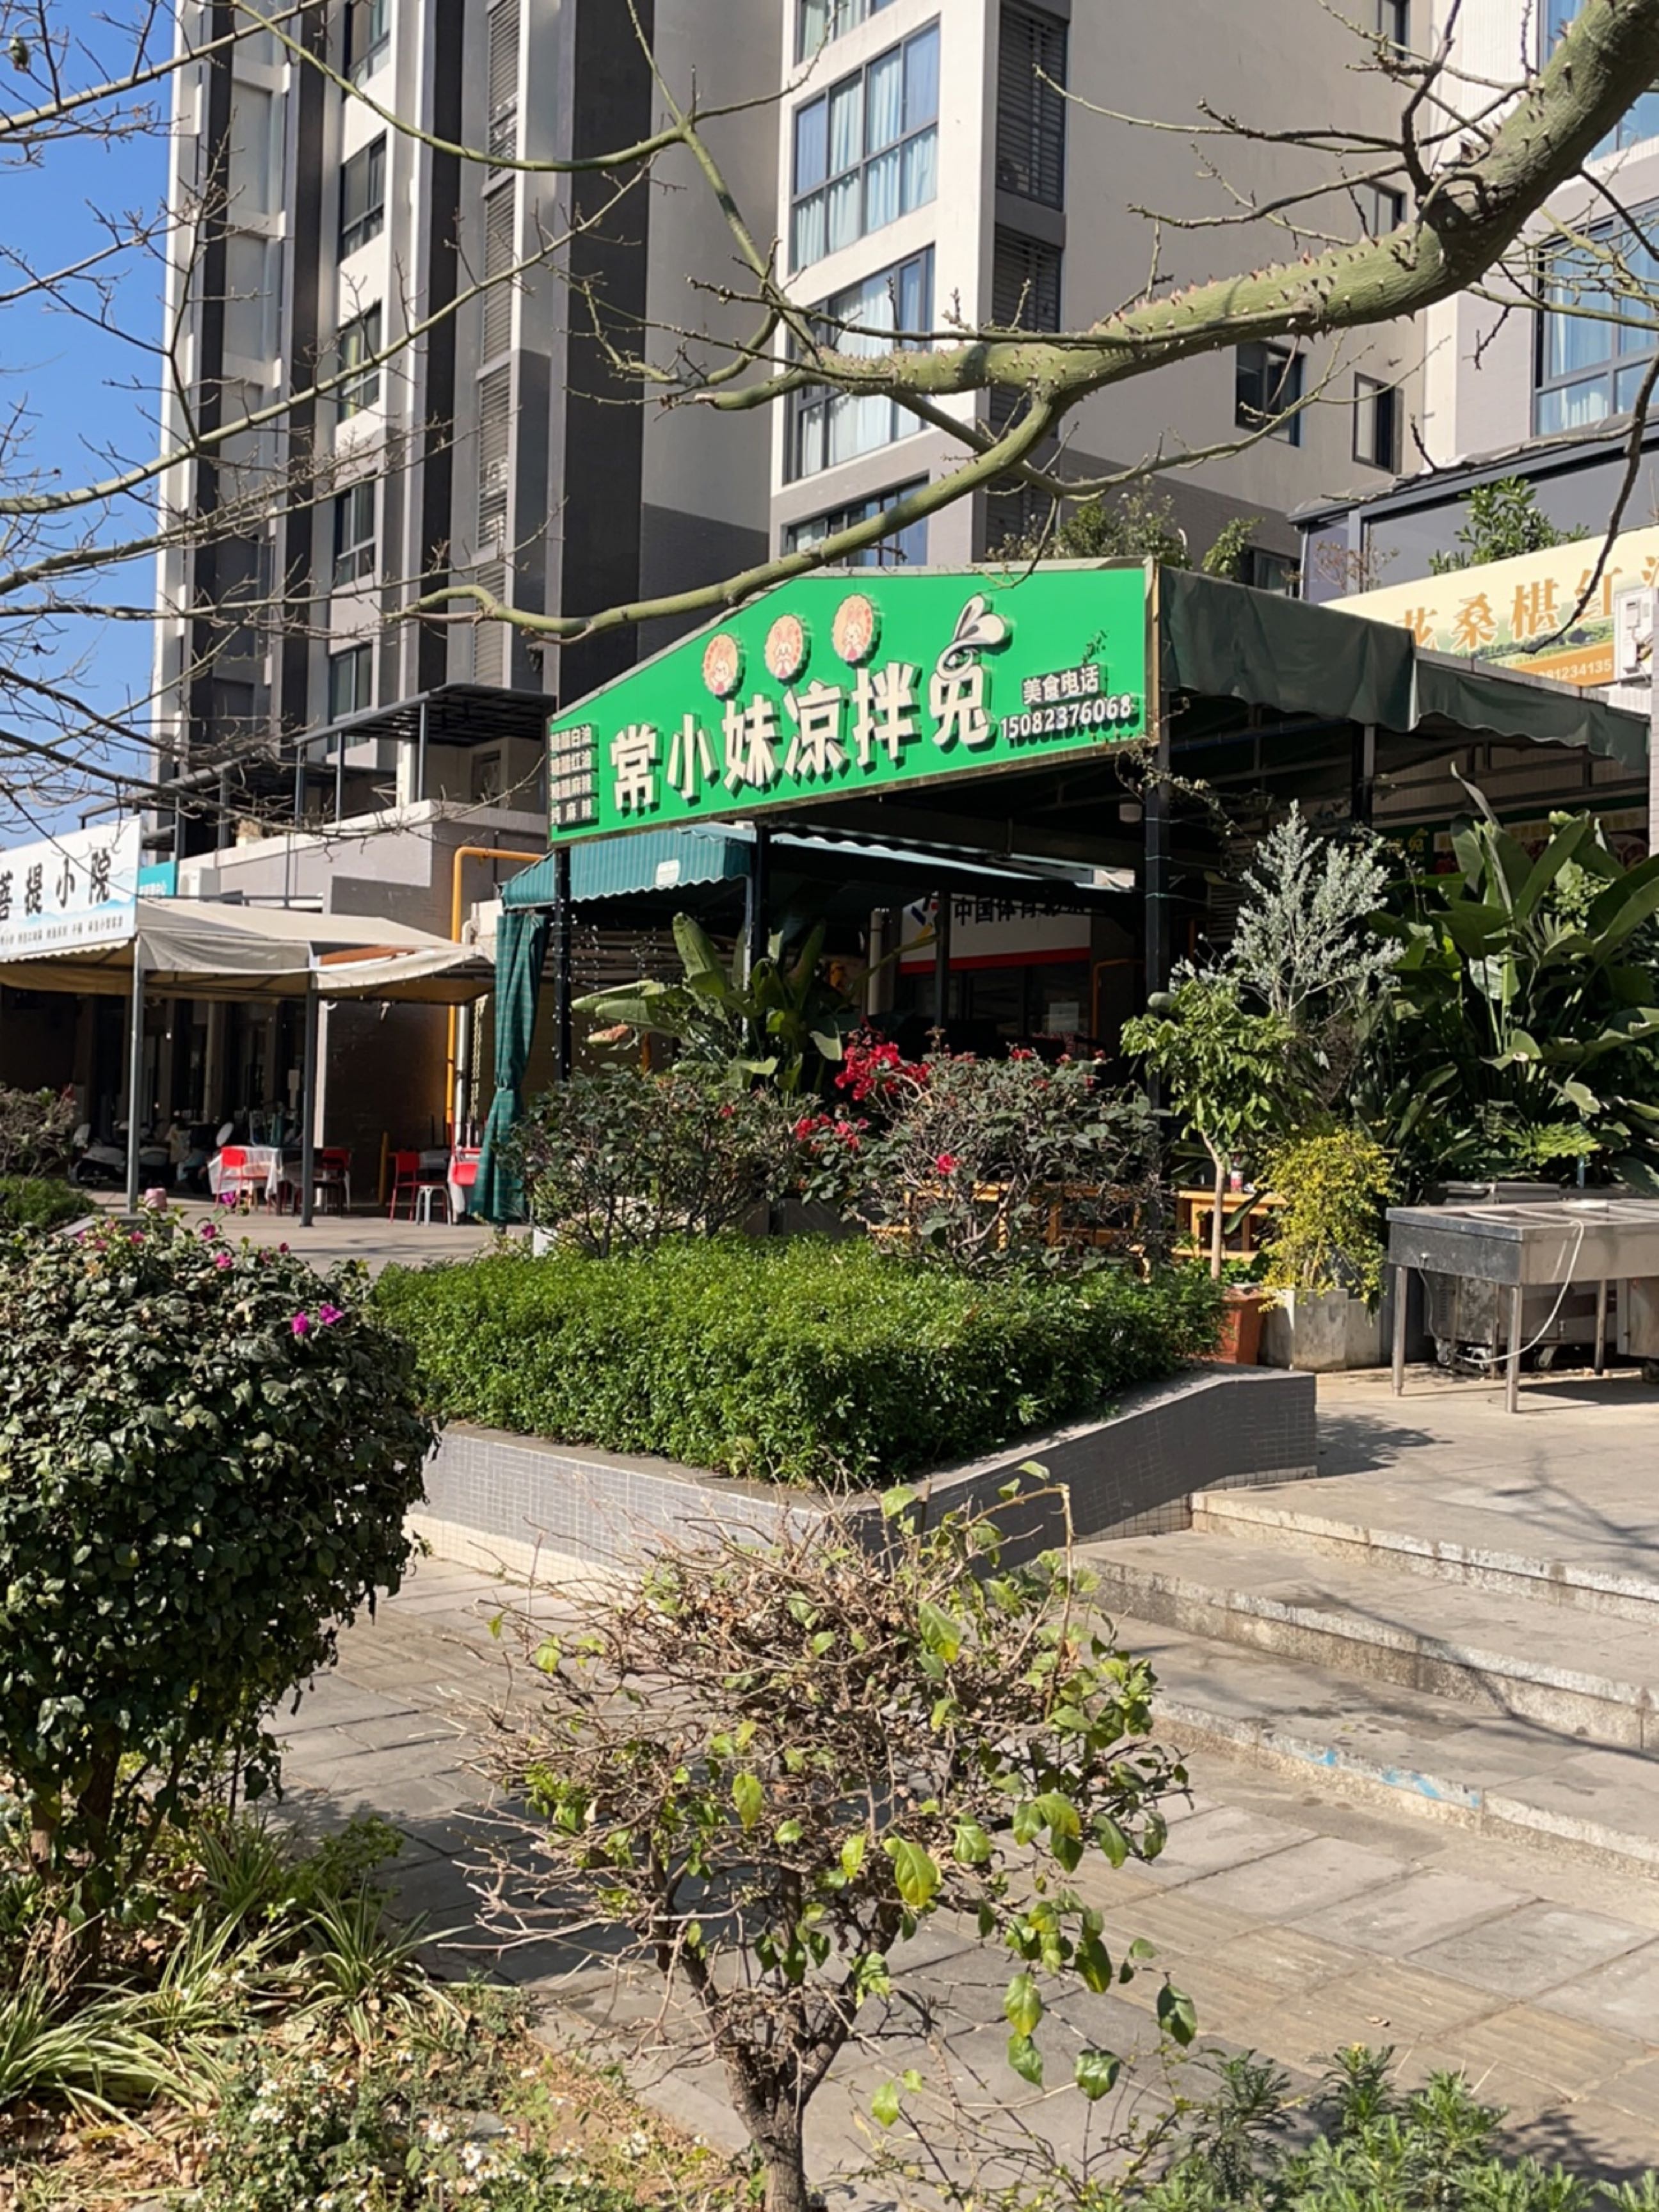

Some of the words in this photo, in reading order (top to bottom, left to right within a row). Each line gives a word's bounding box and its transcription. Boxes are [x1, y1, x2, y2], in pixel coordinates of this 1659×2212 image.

[1023, 664, 1100, 705] 美食电话
[609, 660, 990, 812] 常小妹凉拌兔
[1000, 693, 1132, 739] 15082376068
